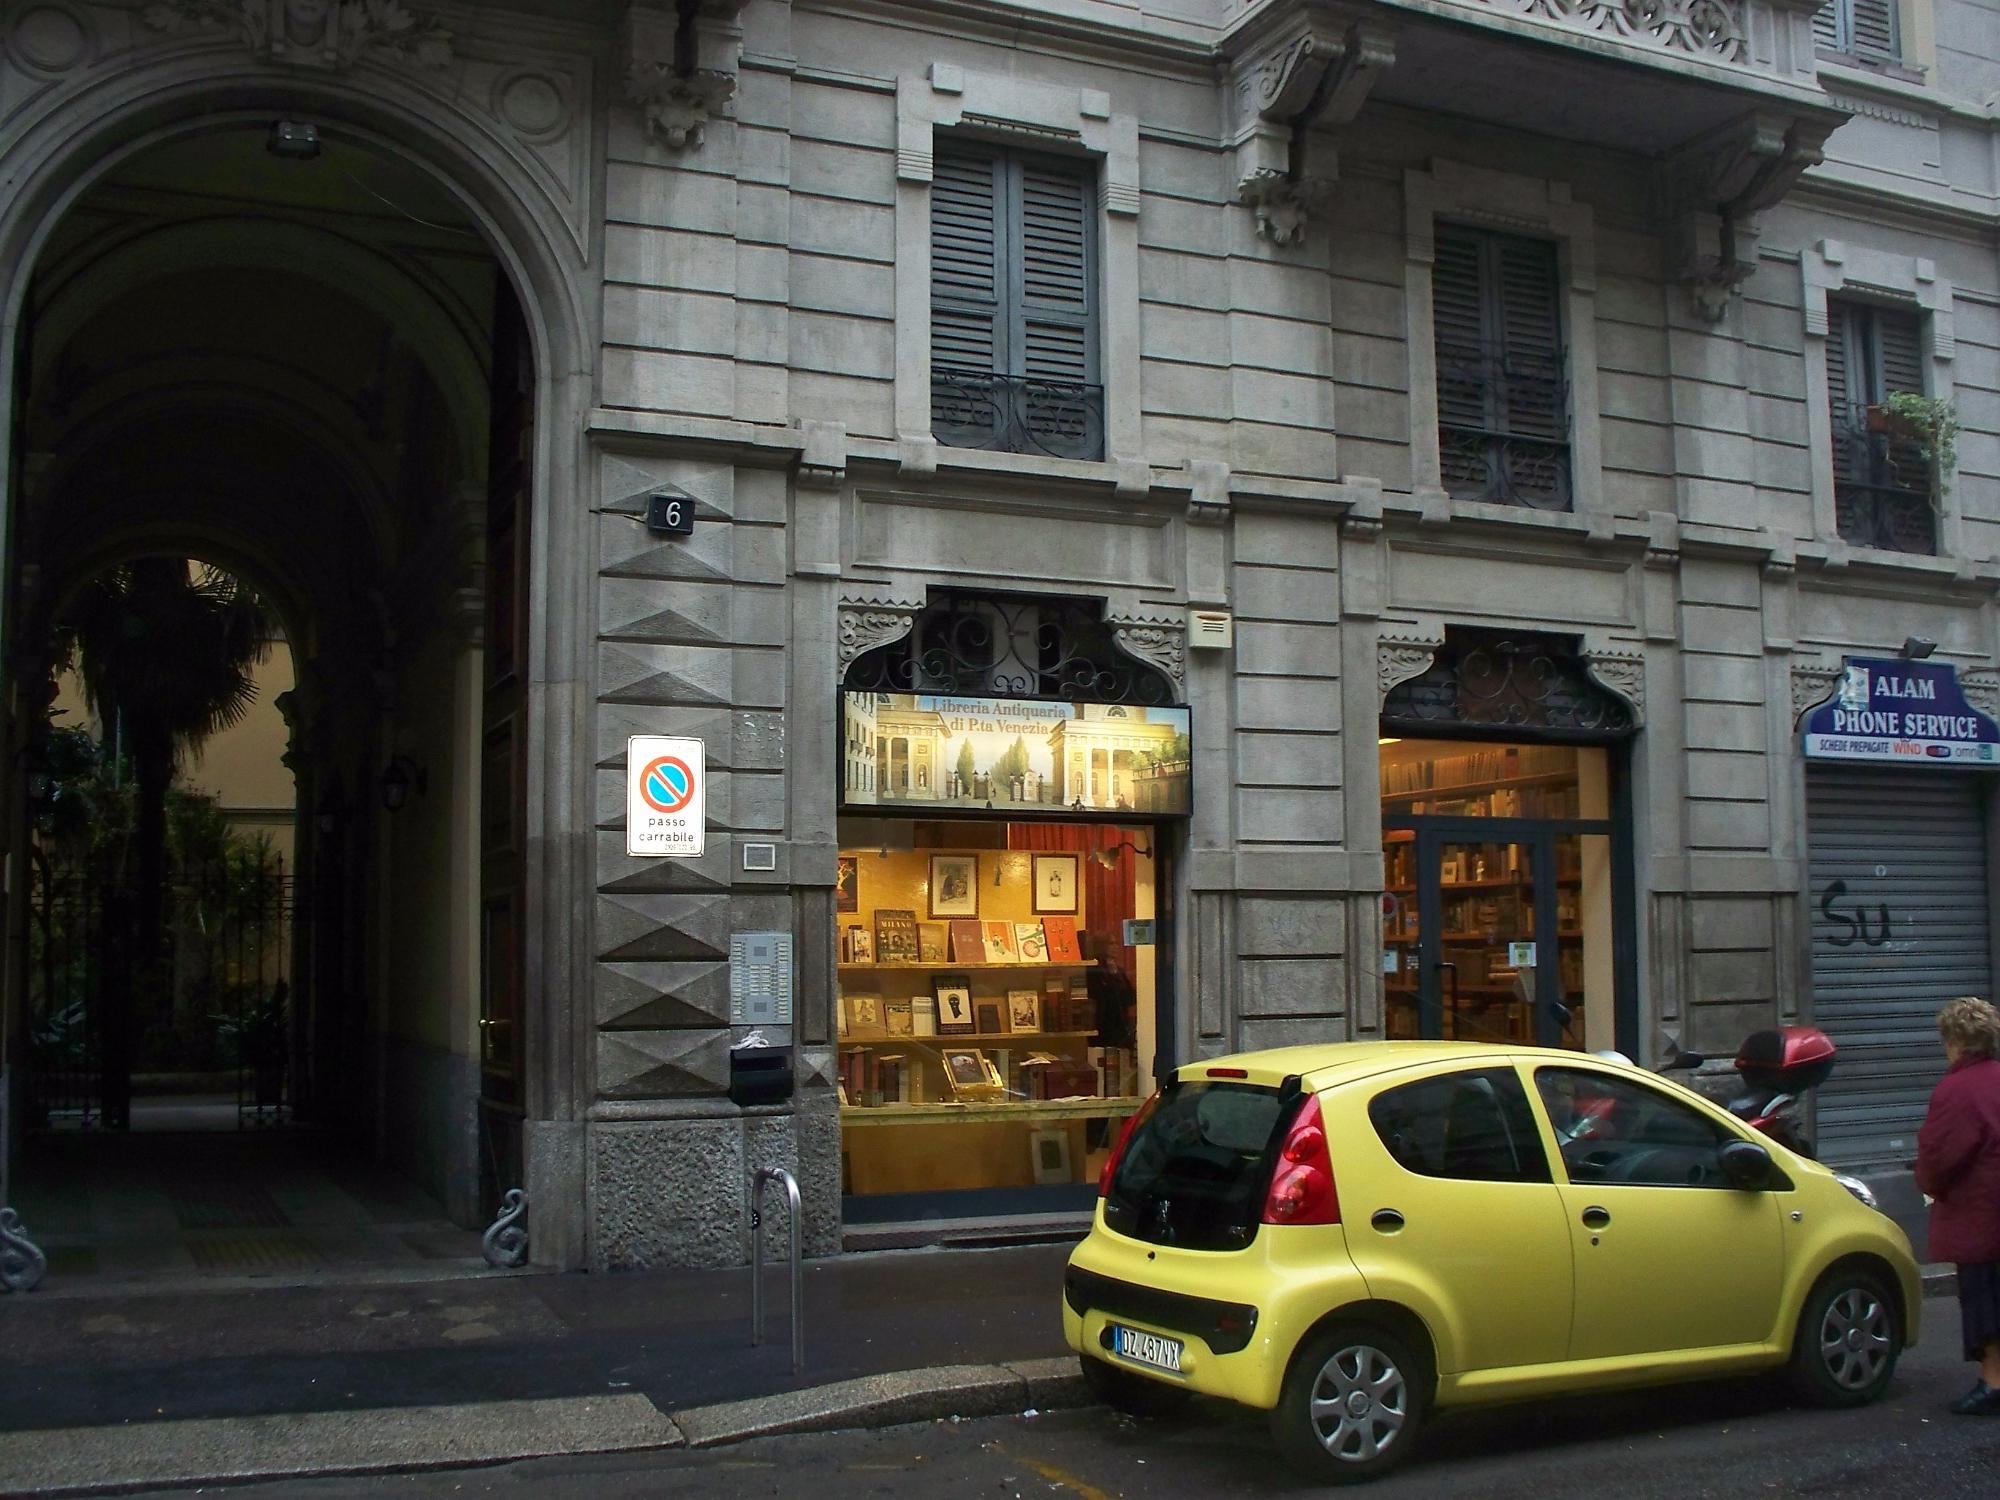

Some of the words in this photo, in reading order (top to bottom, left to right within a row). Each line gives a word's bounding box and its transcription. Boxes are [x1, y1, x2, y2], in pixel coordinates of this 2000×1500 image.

[666, 502, 681, 527] 6
[1875, 676, 1936, 700] ALAM
[931, 697, 990, 715] Libreria
[992, 702, 1067, 720] Antiquaria
[950, 717, 964, 731] di
[968, 718, 994, 733] P.ta
[996, 719, 1049, 735] Venezia
[1833, 709, 1900, 735] PHONE
[1904, 713, 1979, 739] SERVICE
[1819, 739, 1848, 752] SCHEDE
[1849, 741, 1889, 754] PREPAGATE
[1893, 742, 1921, 755] WIND
[648, 818, 686, 828] passo
[638, 832, 694, 842] carrabile
[1123, 1330, 1138, 1357] DZ
[1141, 1335, 1181, 1369] 487YX
